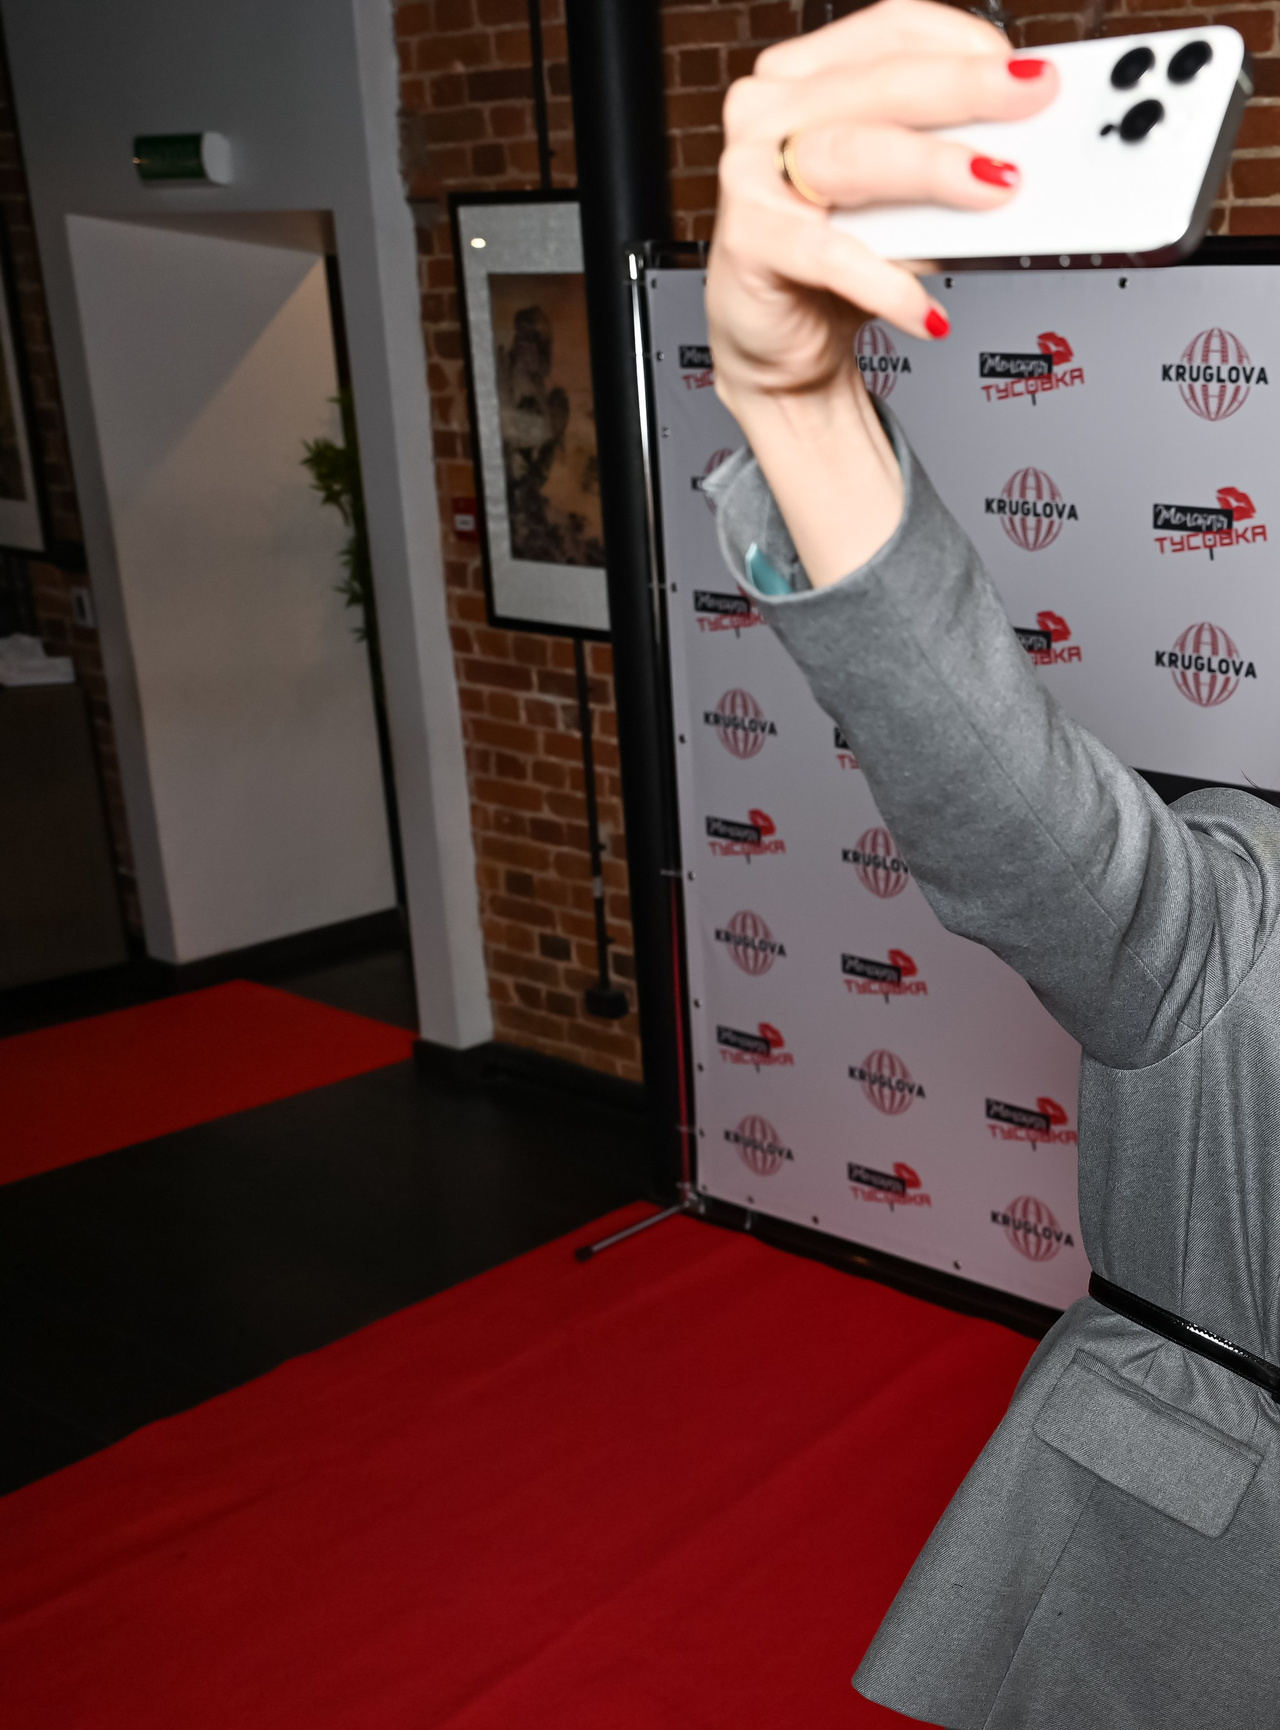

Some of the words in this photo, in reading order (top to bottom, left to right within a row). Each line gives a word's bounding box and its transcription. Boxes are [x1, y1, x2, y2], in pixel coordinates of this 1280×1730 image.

[856, 355, 911, 374] GLOVA
[1162, 364, 1269, 385] KRUGLOVA
[981, 367, 1085, 402] ТУСОВКА
[984, 497, 1078, 521] KRUGLOVA
[1153, 524, 1267, 555] ТУСОВКА
[1155, 650, 1257, 679] KRUGLOVA
[991, 1209, 1075, 1248] KRUGLOVA
